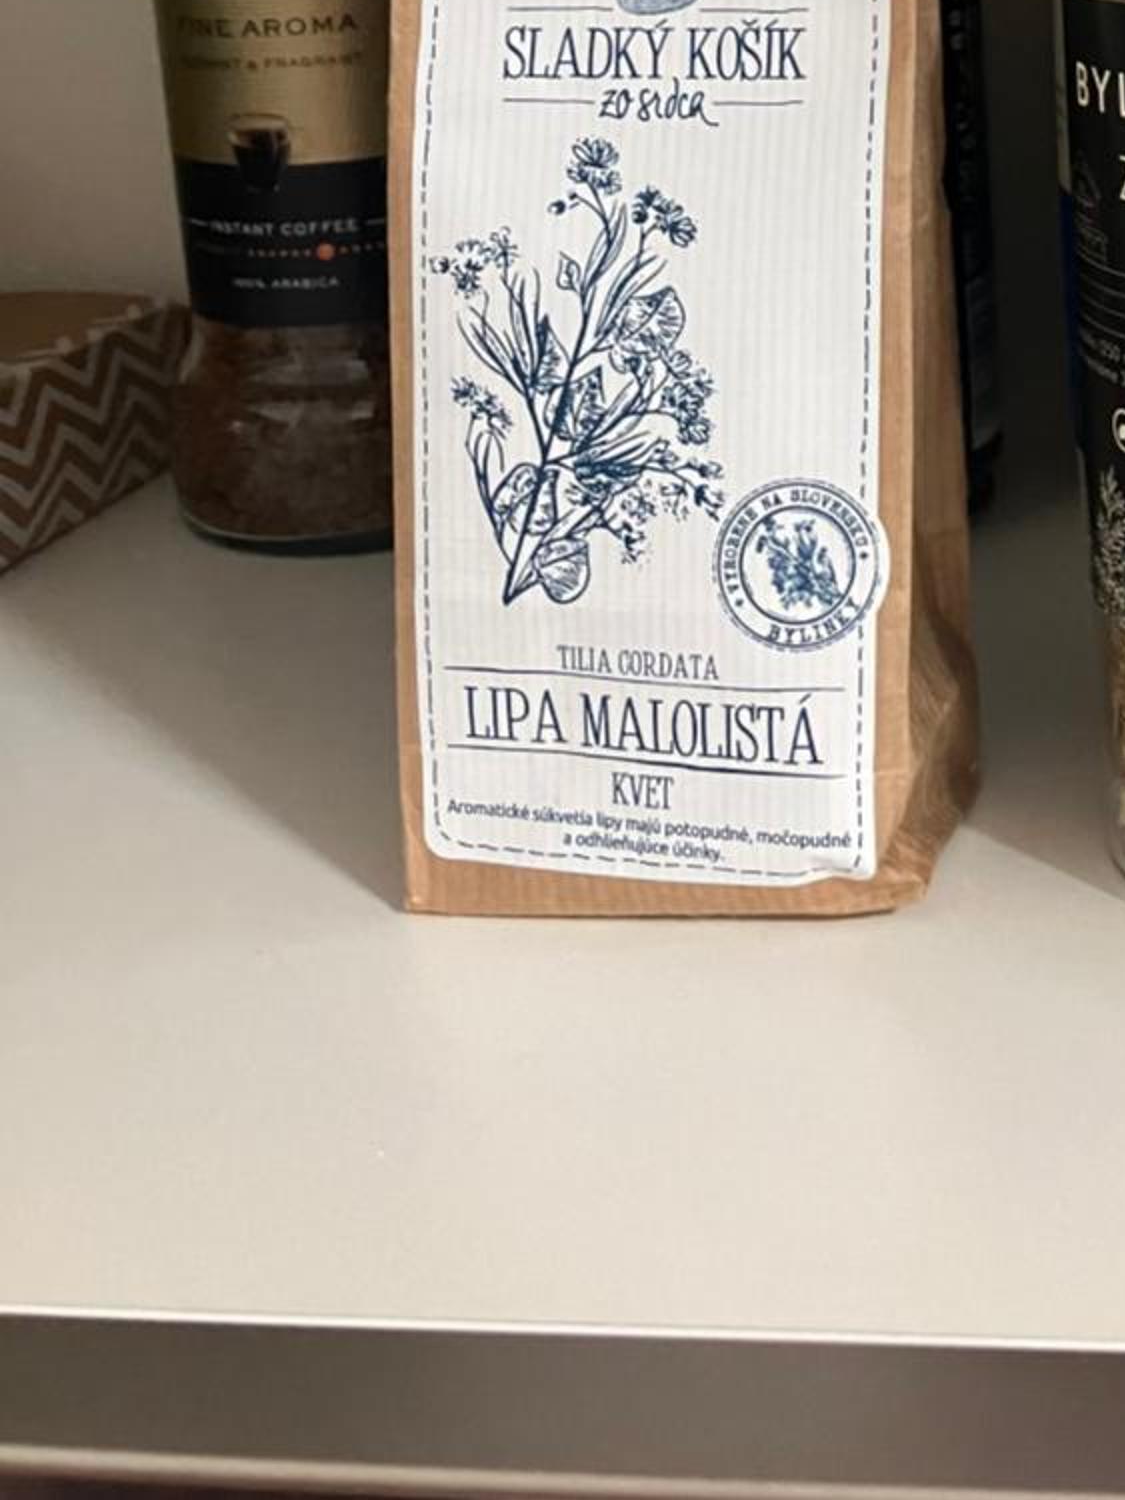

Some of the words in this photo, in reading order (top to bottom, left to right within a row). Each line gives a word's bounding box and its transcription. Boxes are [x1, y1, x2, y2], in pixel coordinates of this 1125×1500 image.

[241, 13, 359, 38] AROMA
[502, 19, 673, 81] SLADKÝ
[686, 18, 808, 82] KOŠÍK
[598, 86, 634, 119] zo
[637, 77, 719, 127] srdca
[280, 217, 360, 236] COFFEE
[767, 595, 861, 644] BYLINKY
[556, 644, 614, 675] TILIA
[618, 650, 720, 682] CORDATA
[463, 685, 568, 744] LIPA
[578, 693, 824, 767] MALOLISTÁ
[610, 771, 674, 812] KVET
[448, 798, 529, 821] Aromatické
[625, 815, 660, 836] majú
[756, 829, 851, 849] močopudné
[562, 832, 572, 846] a
